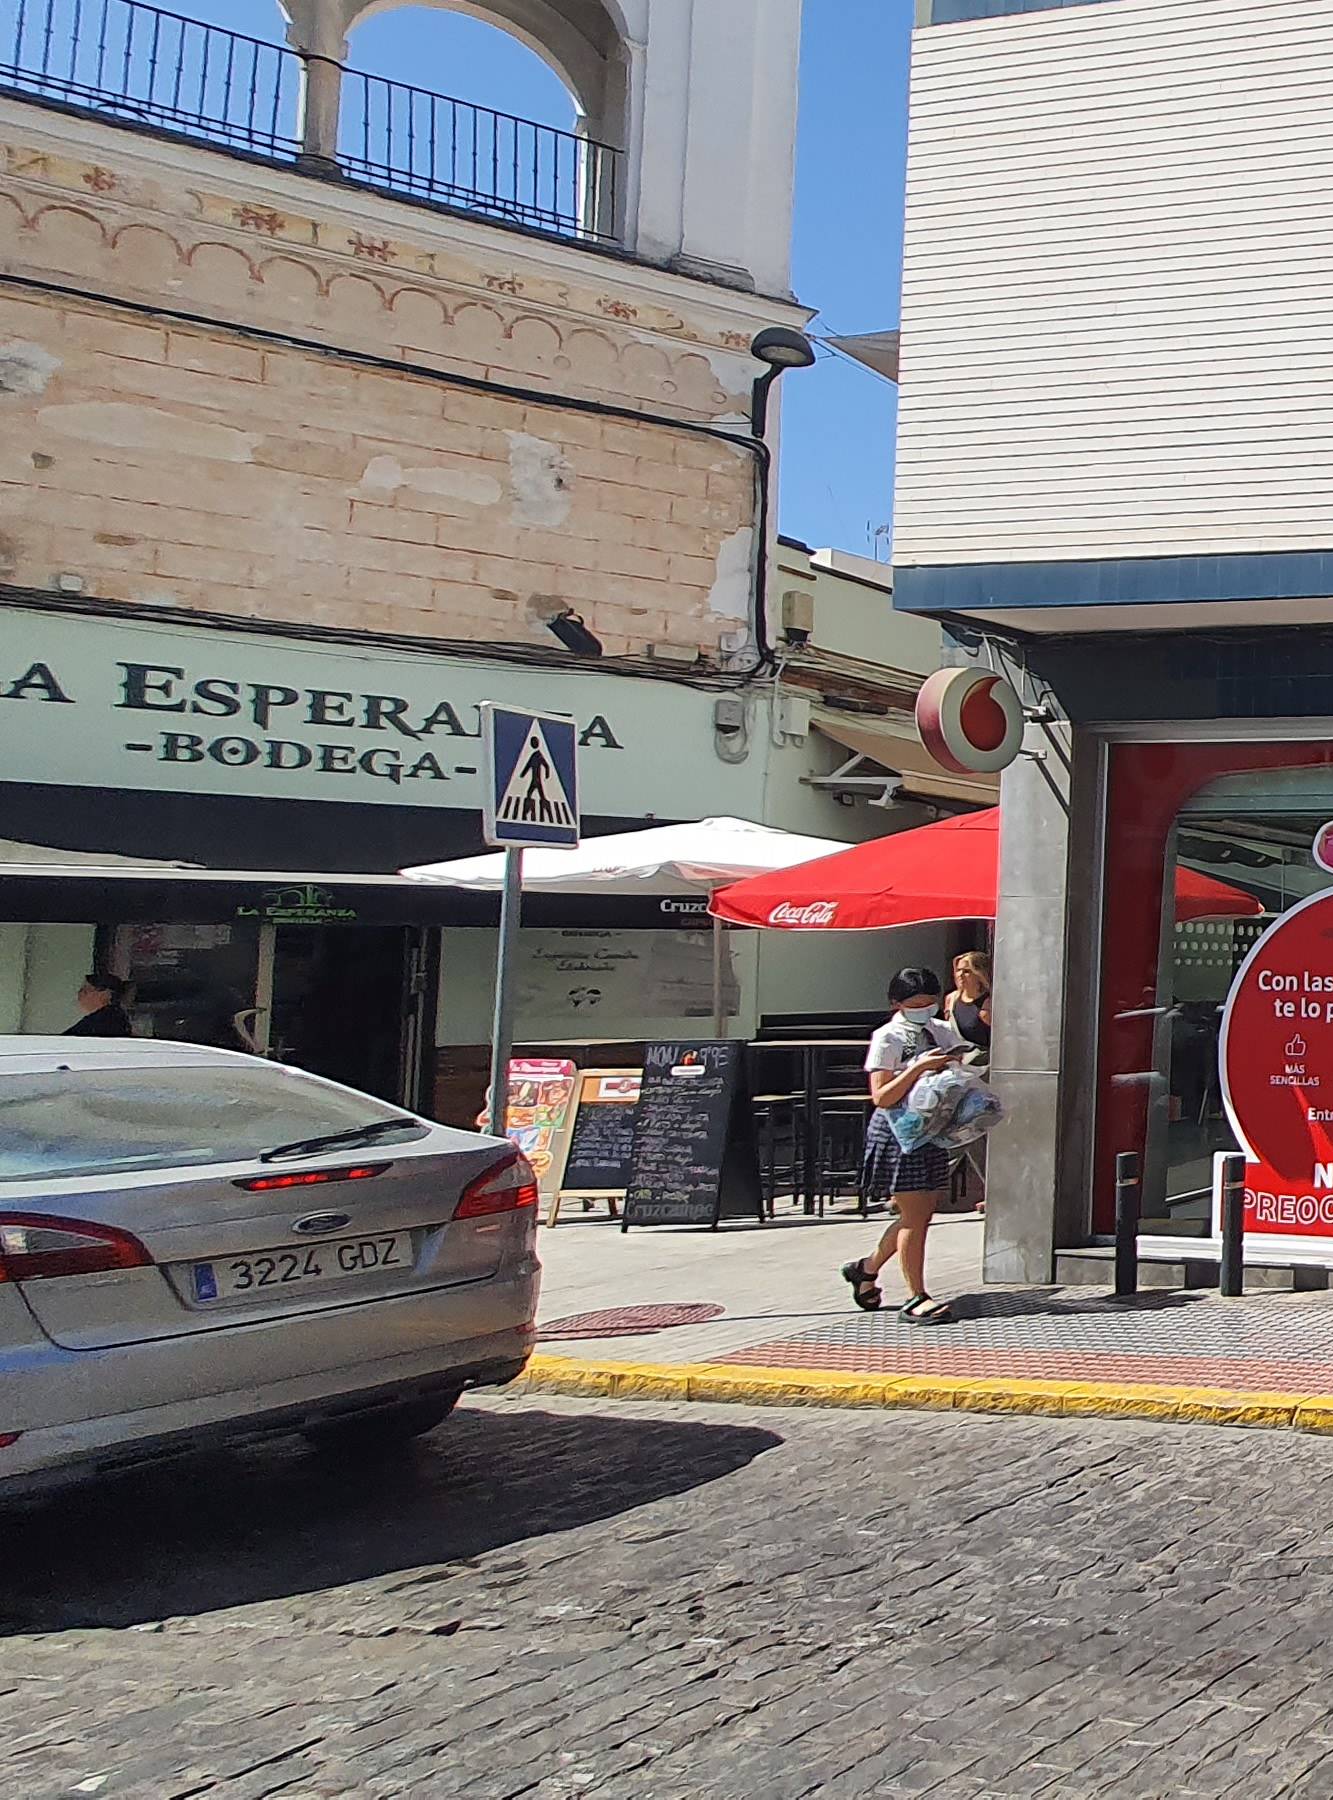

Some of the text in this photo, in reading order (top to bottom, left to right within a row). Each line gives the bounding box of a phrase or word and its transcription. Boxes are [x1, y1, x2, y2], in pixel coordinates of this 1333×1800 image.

[0, 661, 625, 749] A ESPERAA
[1258, 970, 1298, 991] Con
[1274, 999, 1295, 1017] te
[1301, 998, 1321, 1018] lo
[1285, 1064, 1305, 1074] MÁS
[1270, 1075, 1320, 1086] SENCILLAS
[230, 1237, 400, 1290] 3224 GDZ
